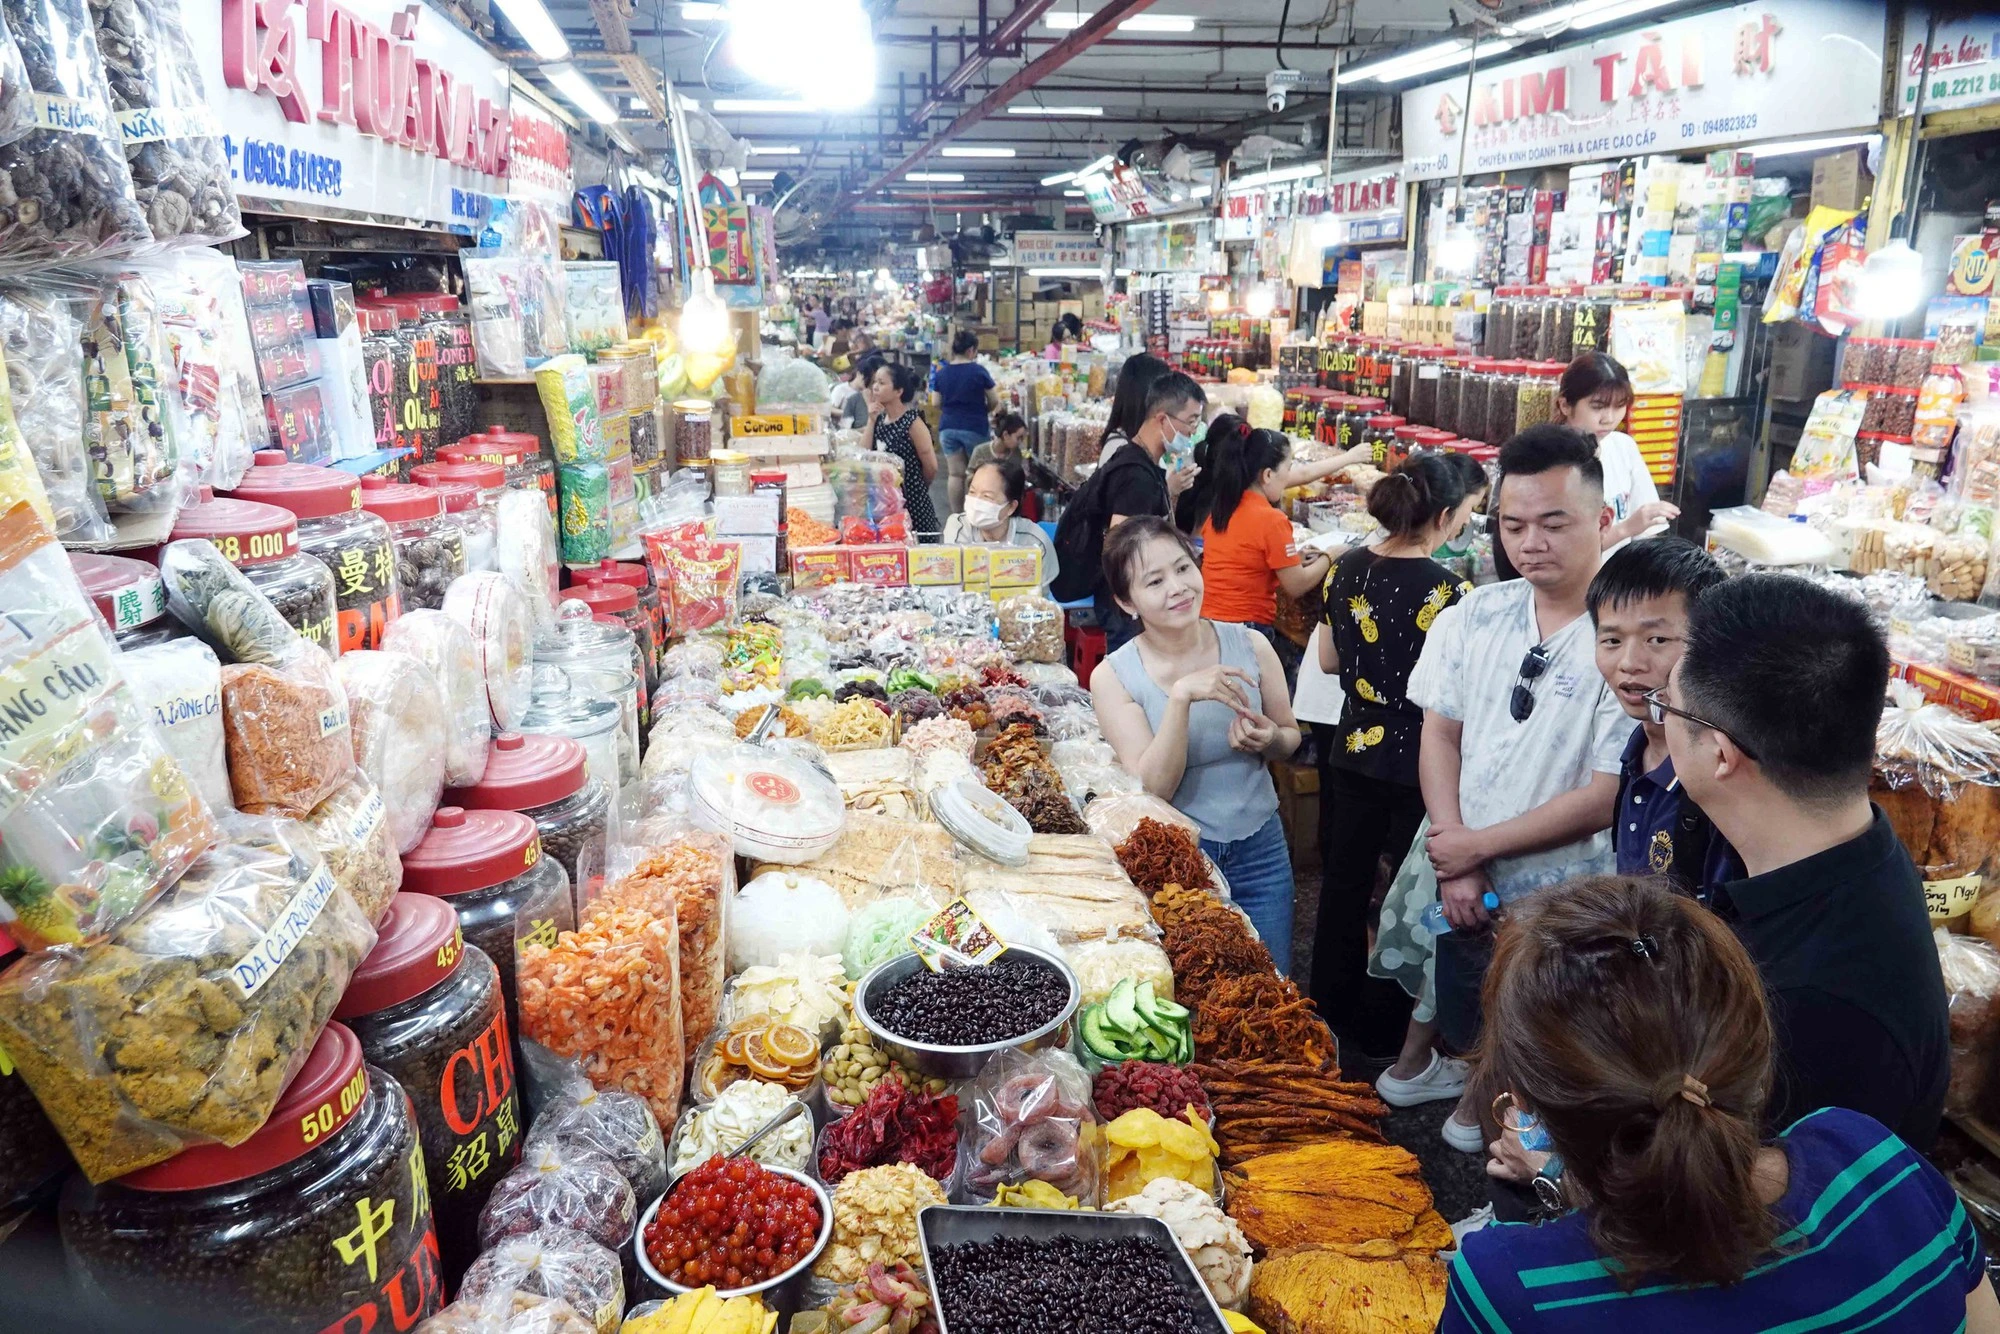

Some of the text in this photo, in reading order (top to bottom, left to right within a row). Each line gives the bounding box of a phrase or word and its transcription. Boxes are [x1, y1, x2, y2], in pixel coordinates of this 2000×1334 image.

[1732, 13, 1783, 77] 財
[1474, 67, 1567, 128] KIM
[1593, 32, 1705, 103] TÀI
[1931, 75, 1984, 99] 08.2212
[1702, 113, 1758, 136] 0948823829
[243, 137, 343, 197] 0903.810358
[1478, 130, 1658, 168] CHUYÊN KINH DOANH TRÀ & CAFE CAO CẤP
[729, 242, 739, 275] SPAR
[1964, 254, 1988, 281] RITZ
[1372, 440, 1388, 462] 香
[234, 955, 268, 990] DA
[265, 929, 292, 965] CÁ
[302, 1067, 366, 1144] 50.000
